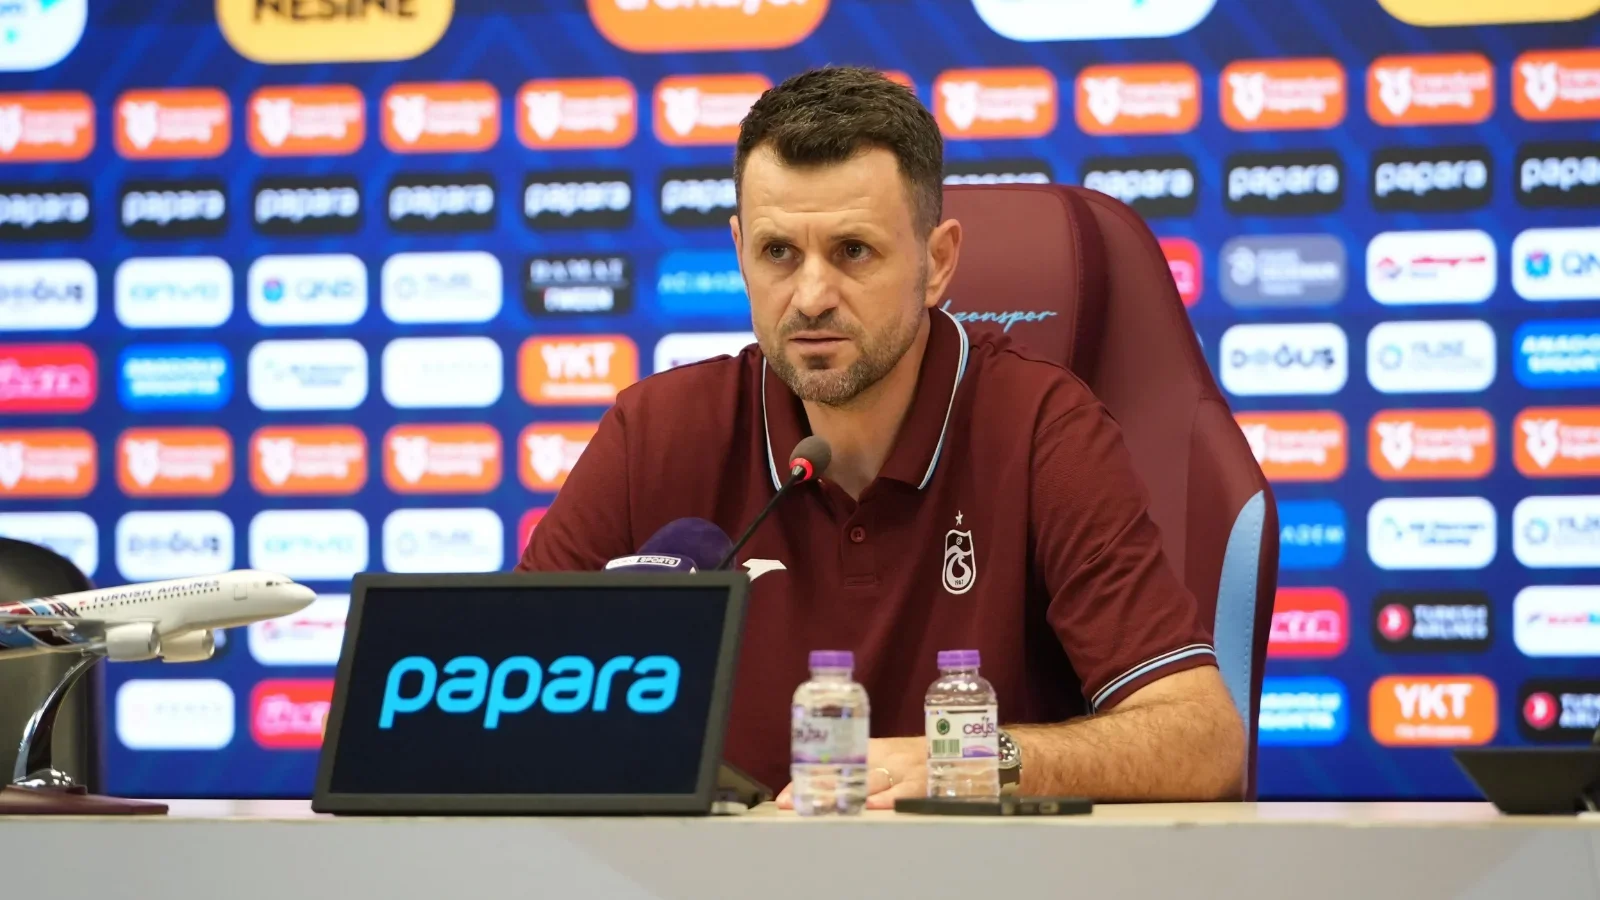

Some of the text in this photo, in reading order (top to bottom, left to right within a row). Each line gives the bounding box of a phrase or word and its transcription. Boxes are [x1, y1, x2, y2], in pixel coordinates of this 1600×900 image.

[1228, 164, 1339, 201] papara
[1375, 160, 1488, 197] papara
[1520, 156, 1600, 192] papa
[661, 179, 737, 215] papa
[1561, 251, 1600, 276] QN
[942, 300, 1058, 333] zonspor
[640, 556, 677, 567] SPORTS
[93, 579, 220, 603] TURKISH AIRLINES
[379, 655, 681, 729] papara
[1393, 683, 1473, 719] YKT
[963, 716, 997, 738] ceys
